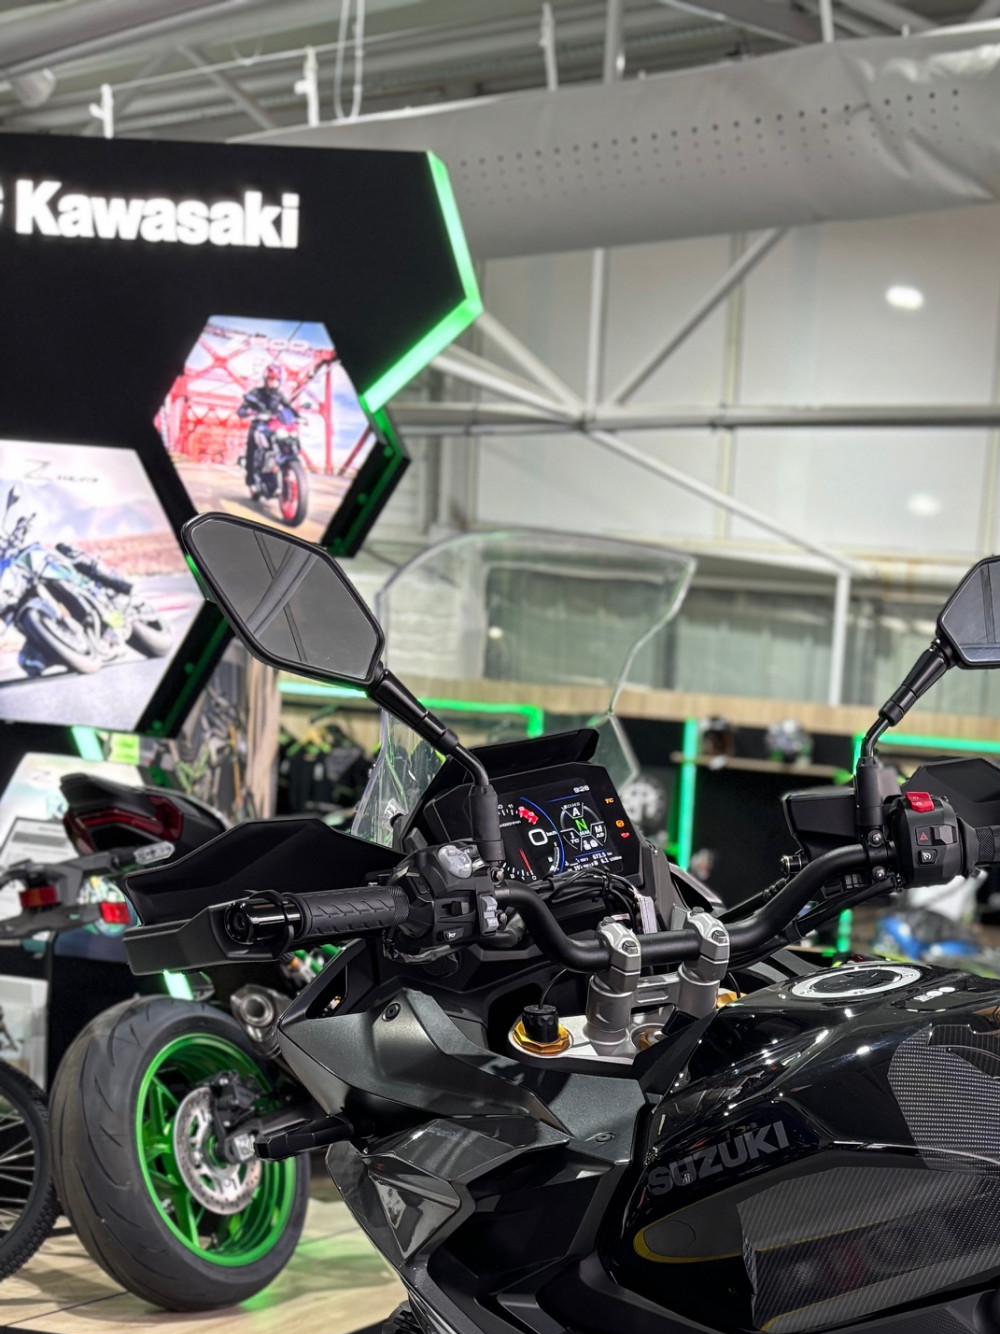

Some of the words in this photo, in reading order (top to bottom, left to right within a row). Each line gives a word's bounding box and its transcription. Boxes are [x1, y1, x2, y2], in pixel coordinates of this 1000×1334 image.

[15, 178, 300, 249] Kawasaki
[572, 807, 581, 817] A
[575, 818, 588, 831] N
[528, 828, 549, 846] 0
[648, 1120, 790, 1196] SUZUKI
